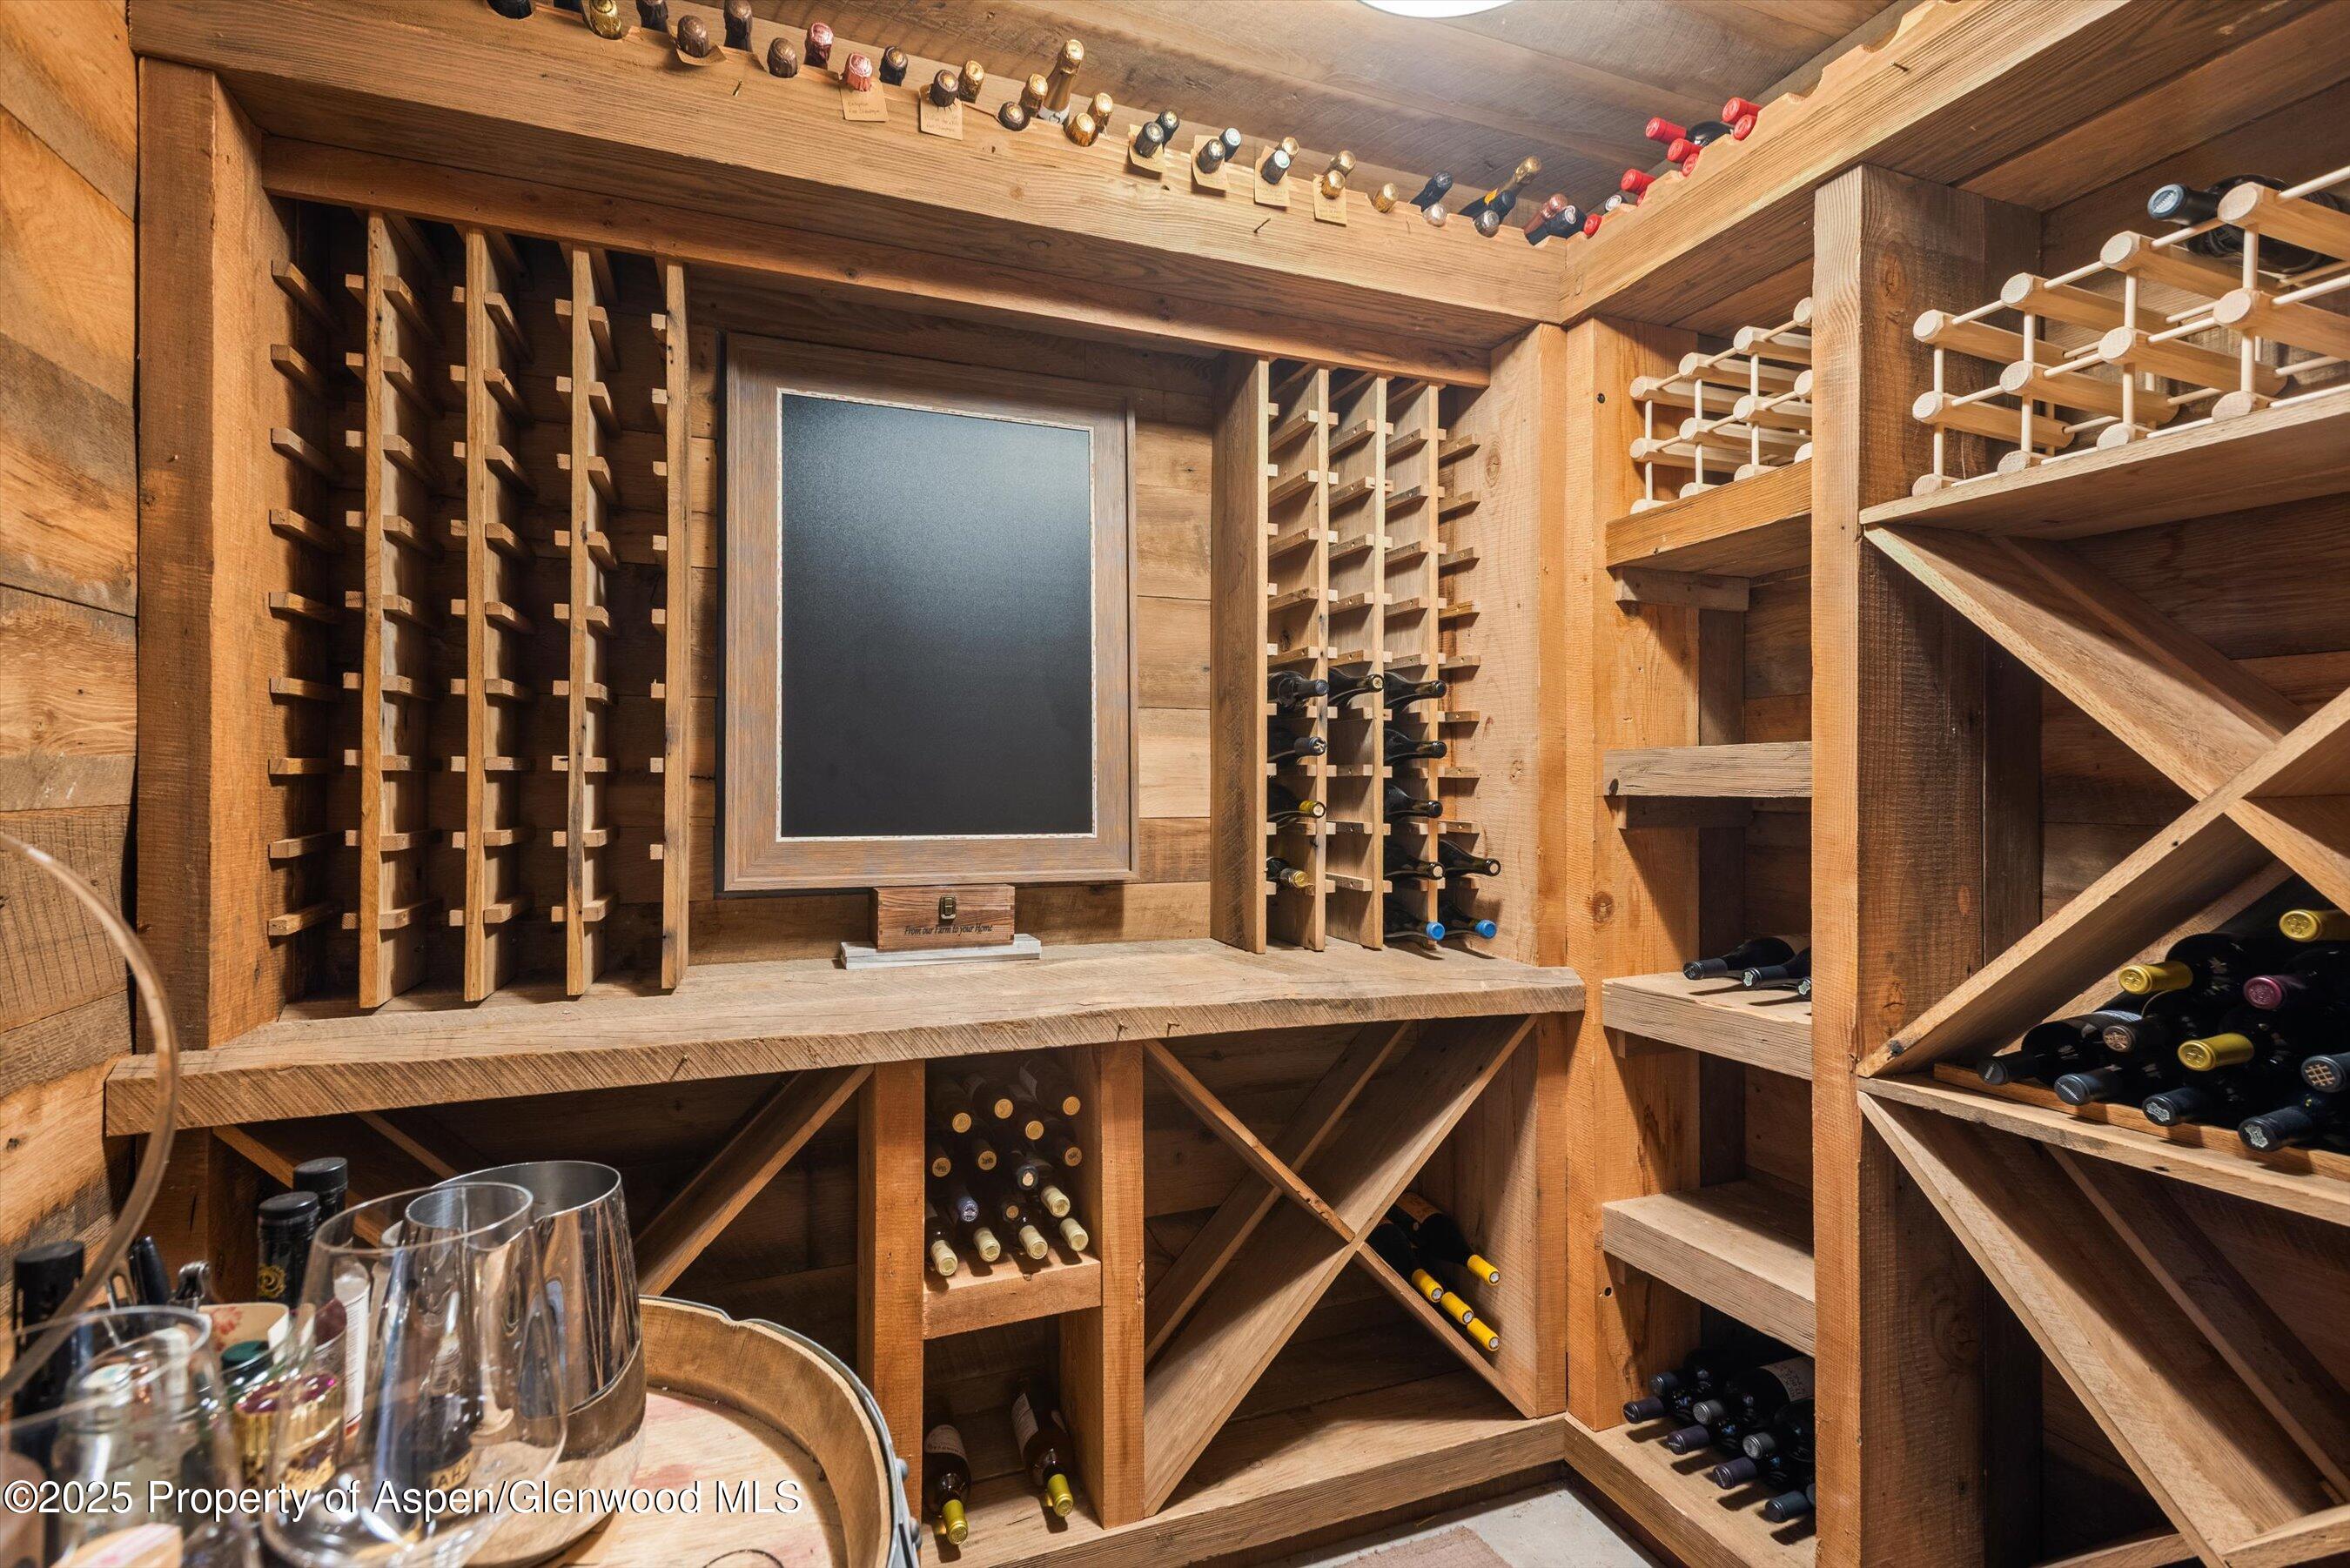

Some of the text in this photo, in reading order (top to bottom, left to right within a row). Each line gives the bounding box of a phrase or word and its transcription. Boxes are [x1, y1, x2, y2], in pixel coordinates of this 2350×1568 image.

[904, 925, 921, 935] From
[934, 924, 951, 935] Farm
[951, 924, 959, 934] to
[958, 925, 974, 936] your
[975, 922, 993, 934] Home
